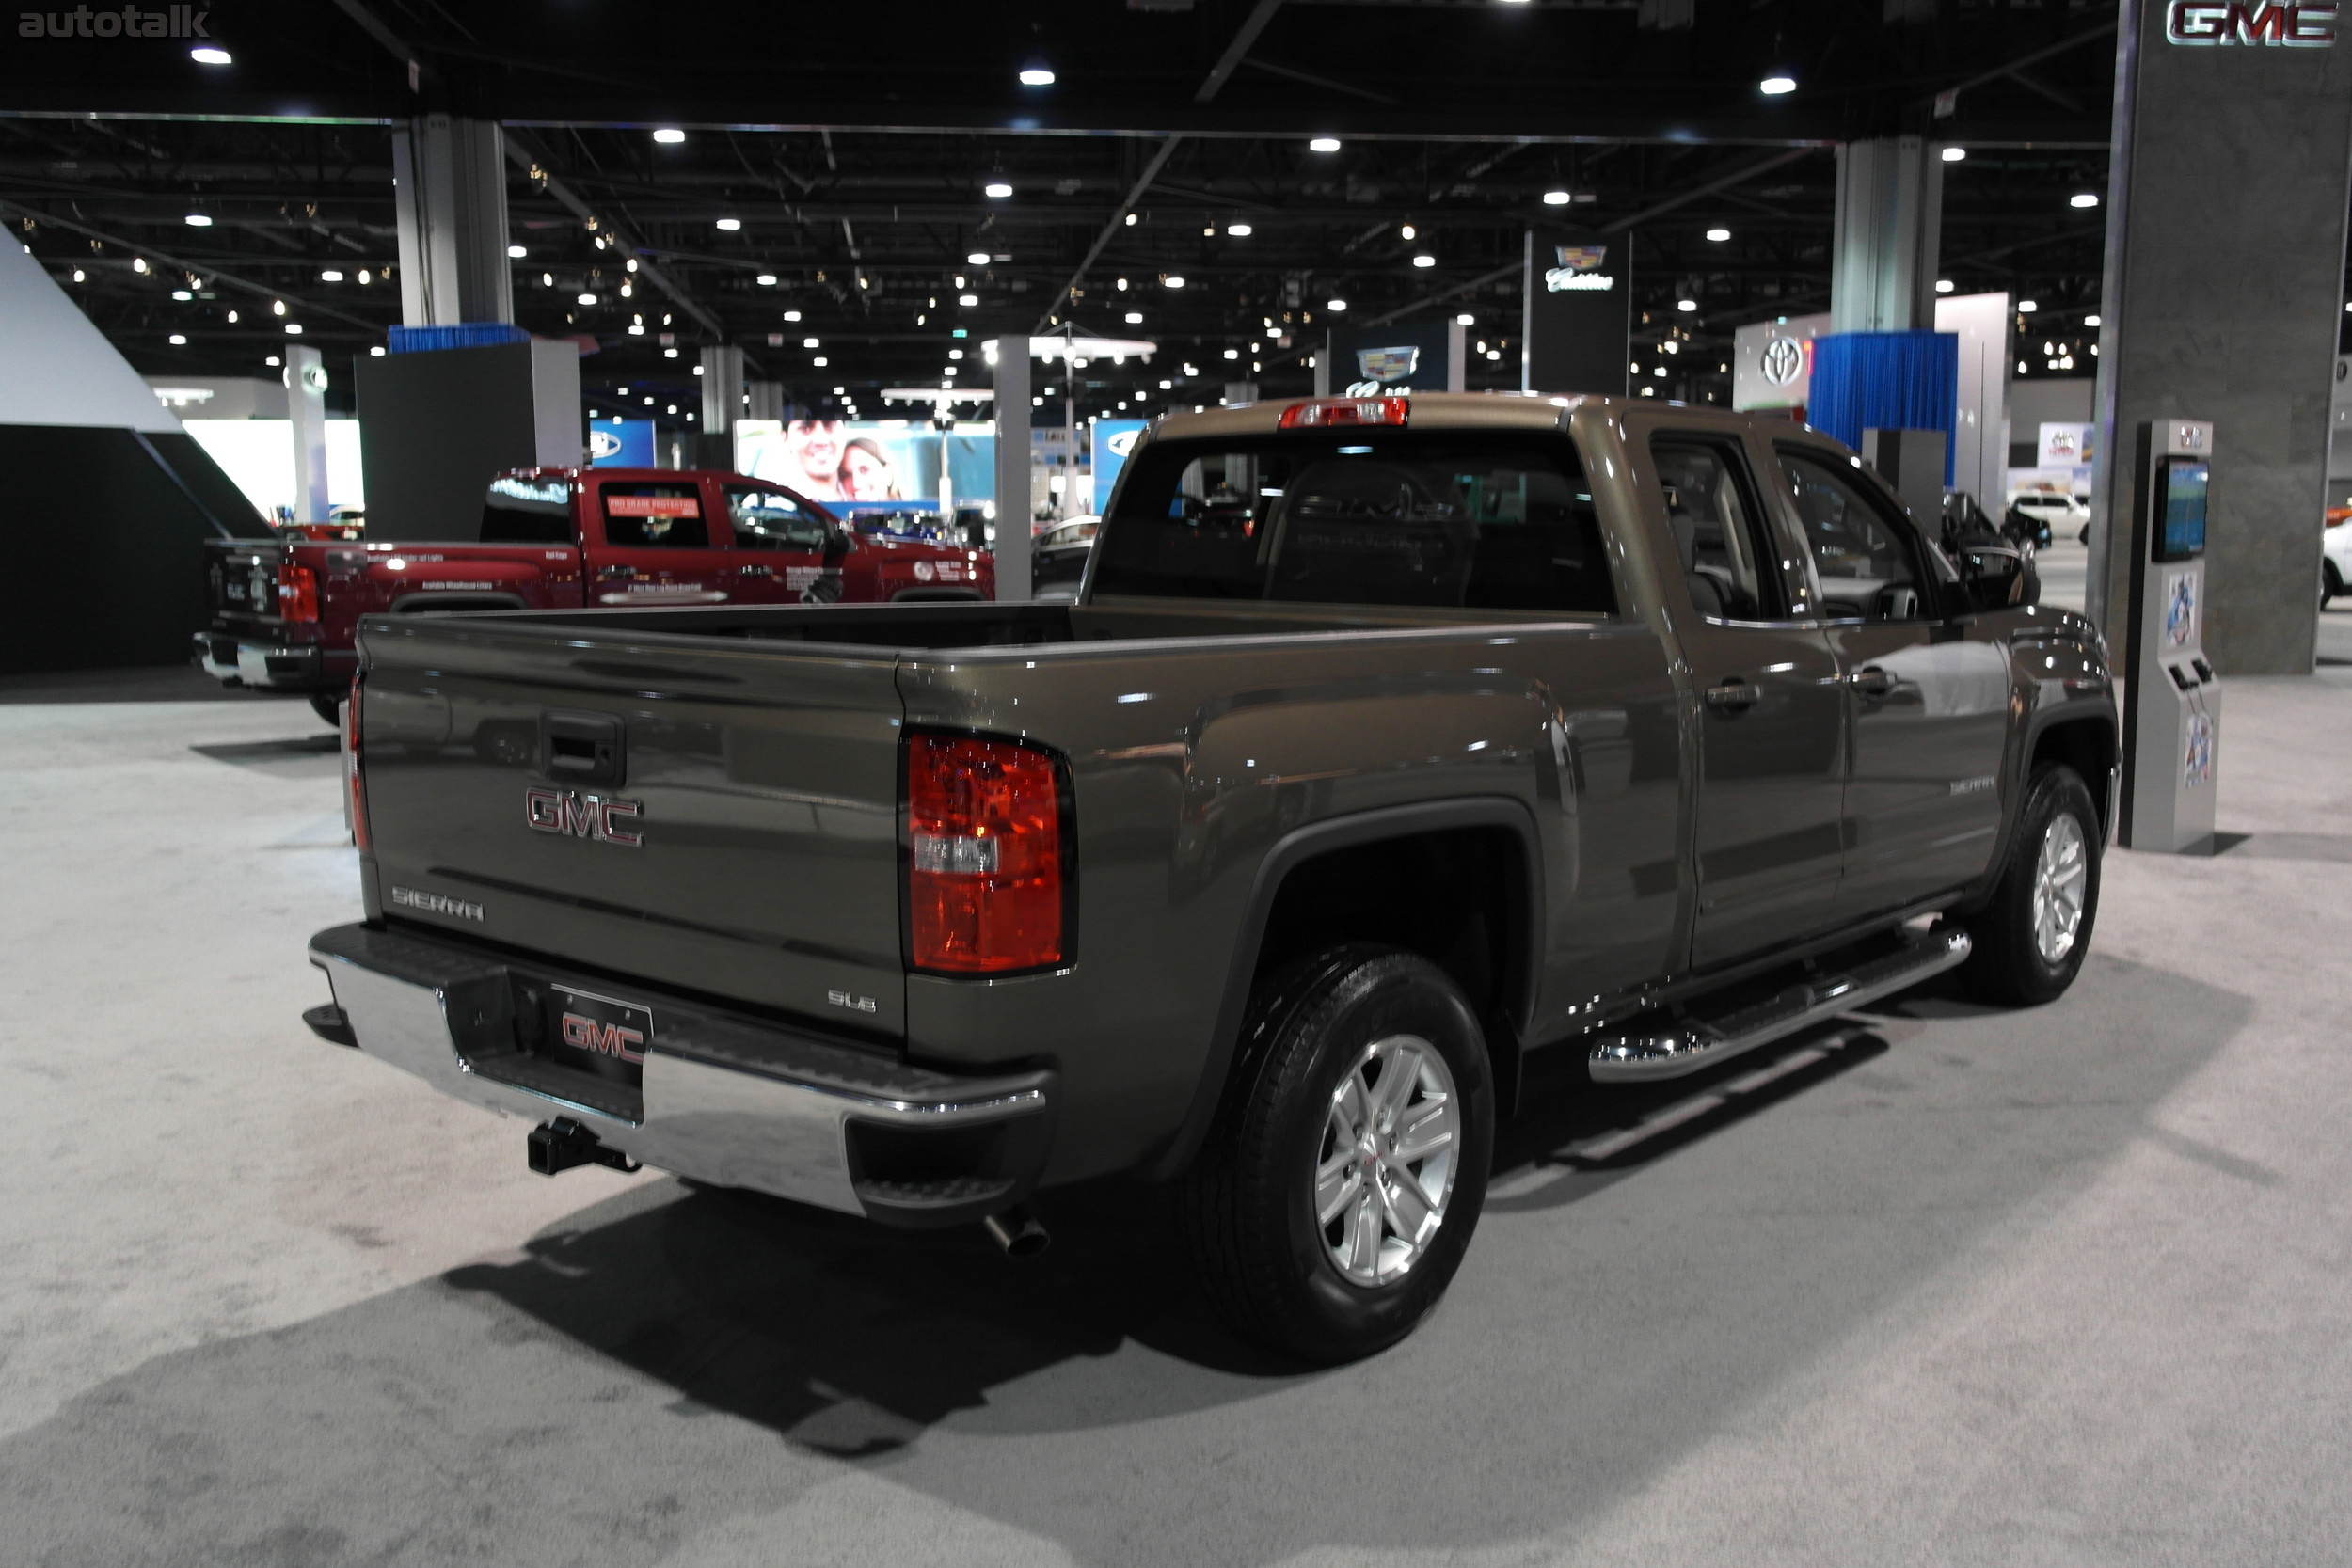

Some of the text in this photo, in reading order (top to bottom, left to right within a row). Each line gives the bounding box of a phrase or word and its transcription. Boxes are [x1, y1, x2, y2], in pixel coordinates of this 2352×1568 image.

[2167, 0, 2339, 46] GMC
[526, 786, 643, 848] GMC
[391, 885, 485, 923] SIERRA
[828, 989, 876, 1014] SLE
[562, 1011, 644, 1065] GMC
